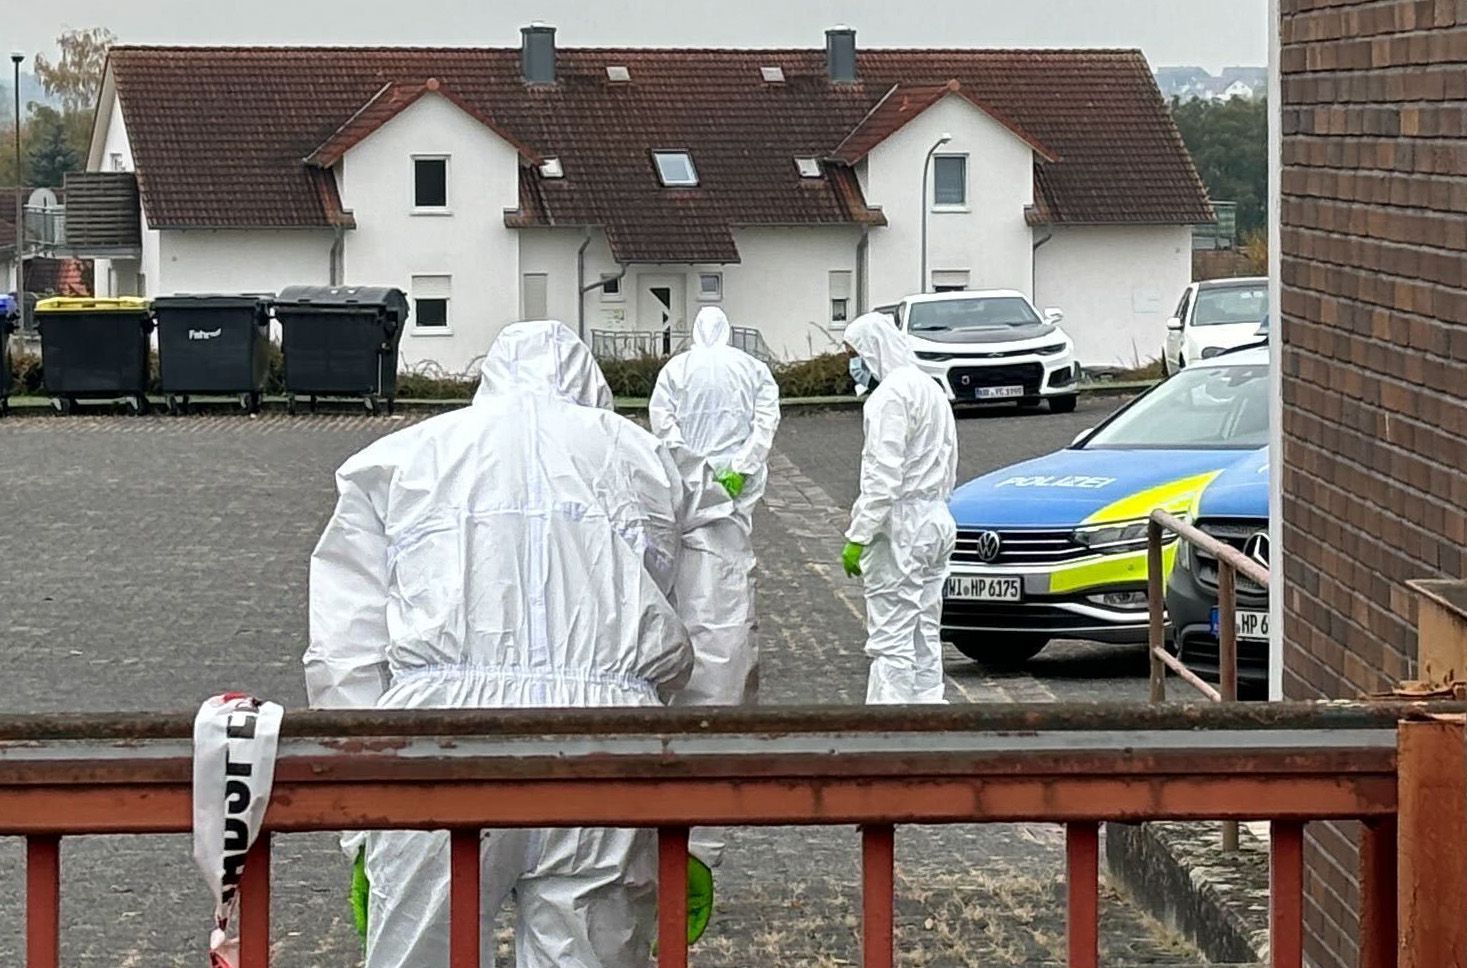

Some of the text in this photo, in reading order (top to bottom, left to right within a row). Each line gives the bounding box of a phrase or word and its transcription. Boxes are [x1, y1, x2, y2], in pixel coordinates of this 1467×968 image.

[995, 475, 1118, 489] POLIZEI
[971, 579, 986, 597] HP
[988, 580, 1018, 598] 6175
[1241, 614, 1269, 635] HP 6
